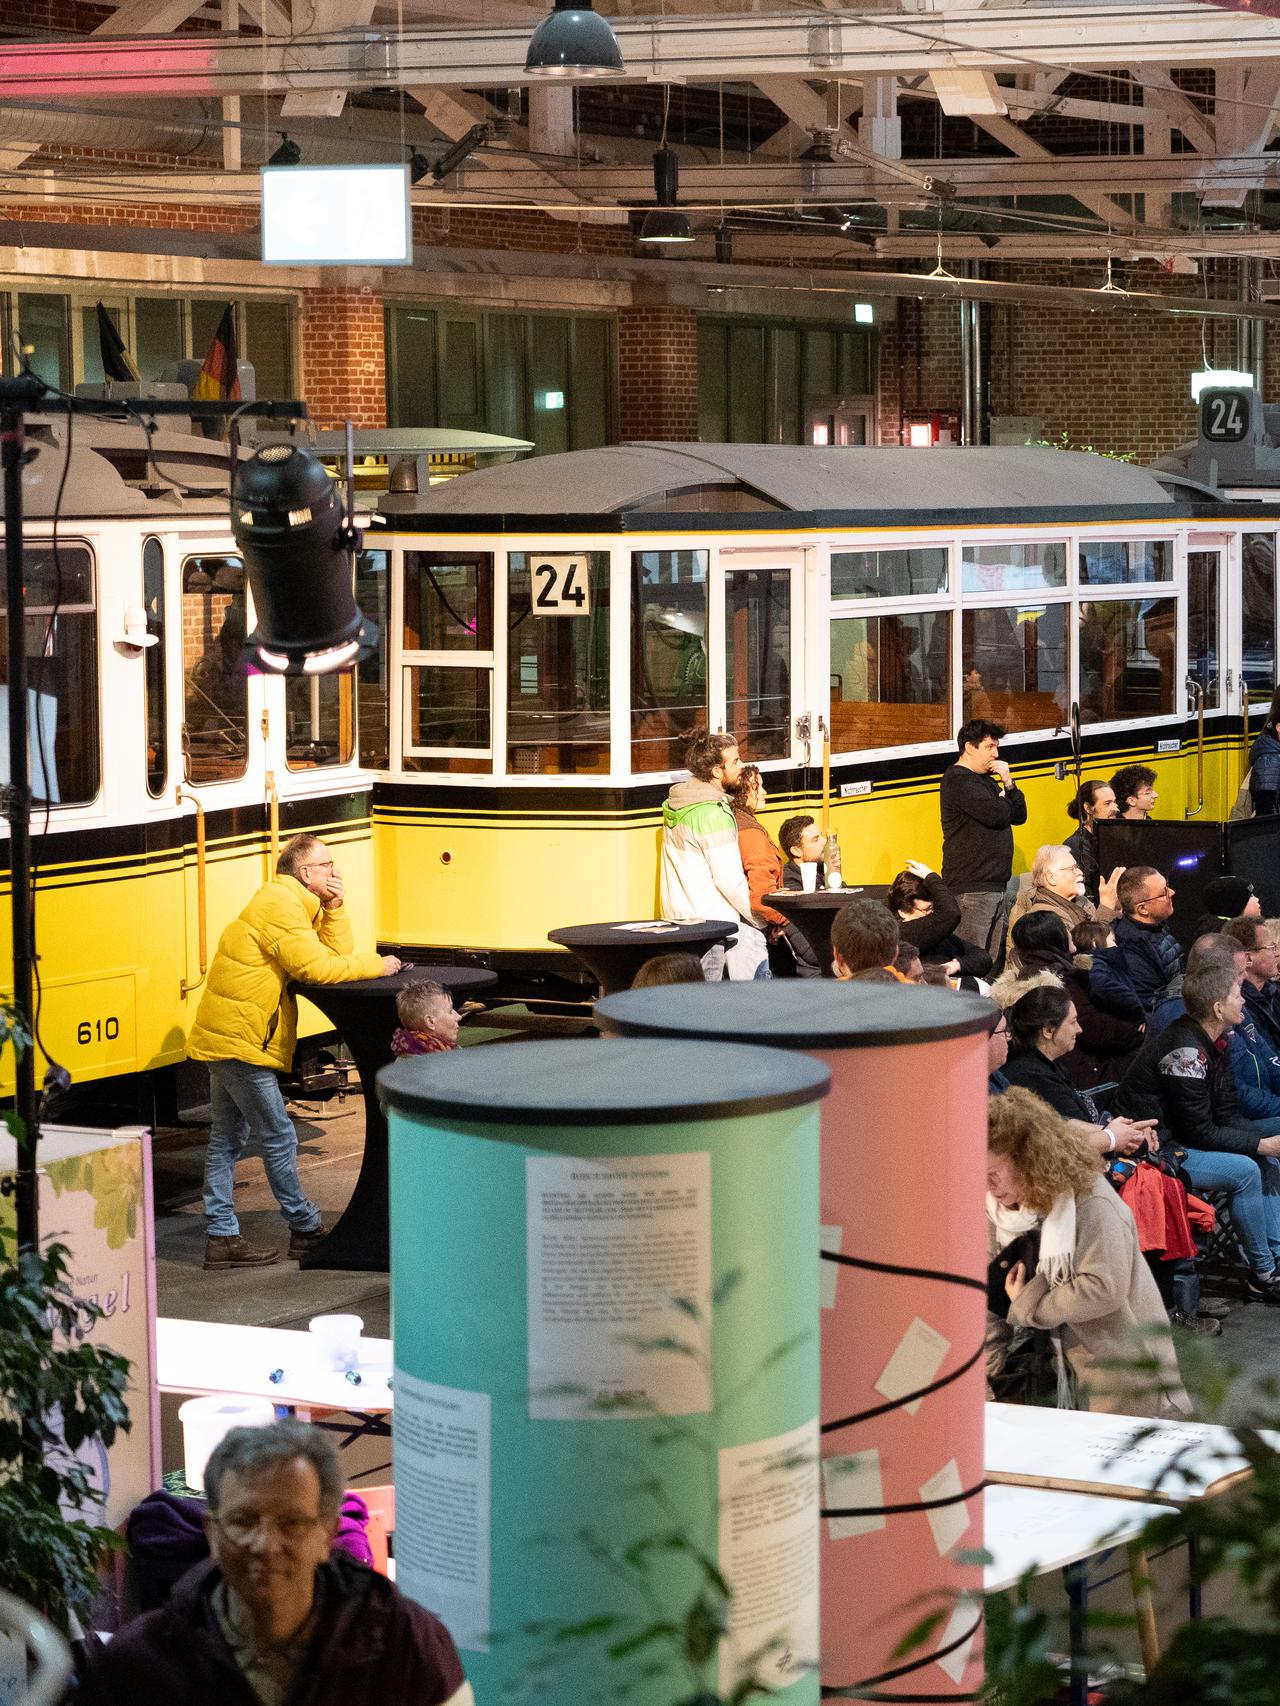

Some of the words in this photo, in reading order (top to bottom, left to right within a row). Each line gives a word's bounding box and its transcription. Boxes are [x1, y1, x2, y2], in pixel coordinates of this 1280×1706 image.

[1211, 398, 1243, 434] 24
[535, 564, 586, 607] 24
[77, 1016, 119, 1045] 610
